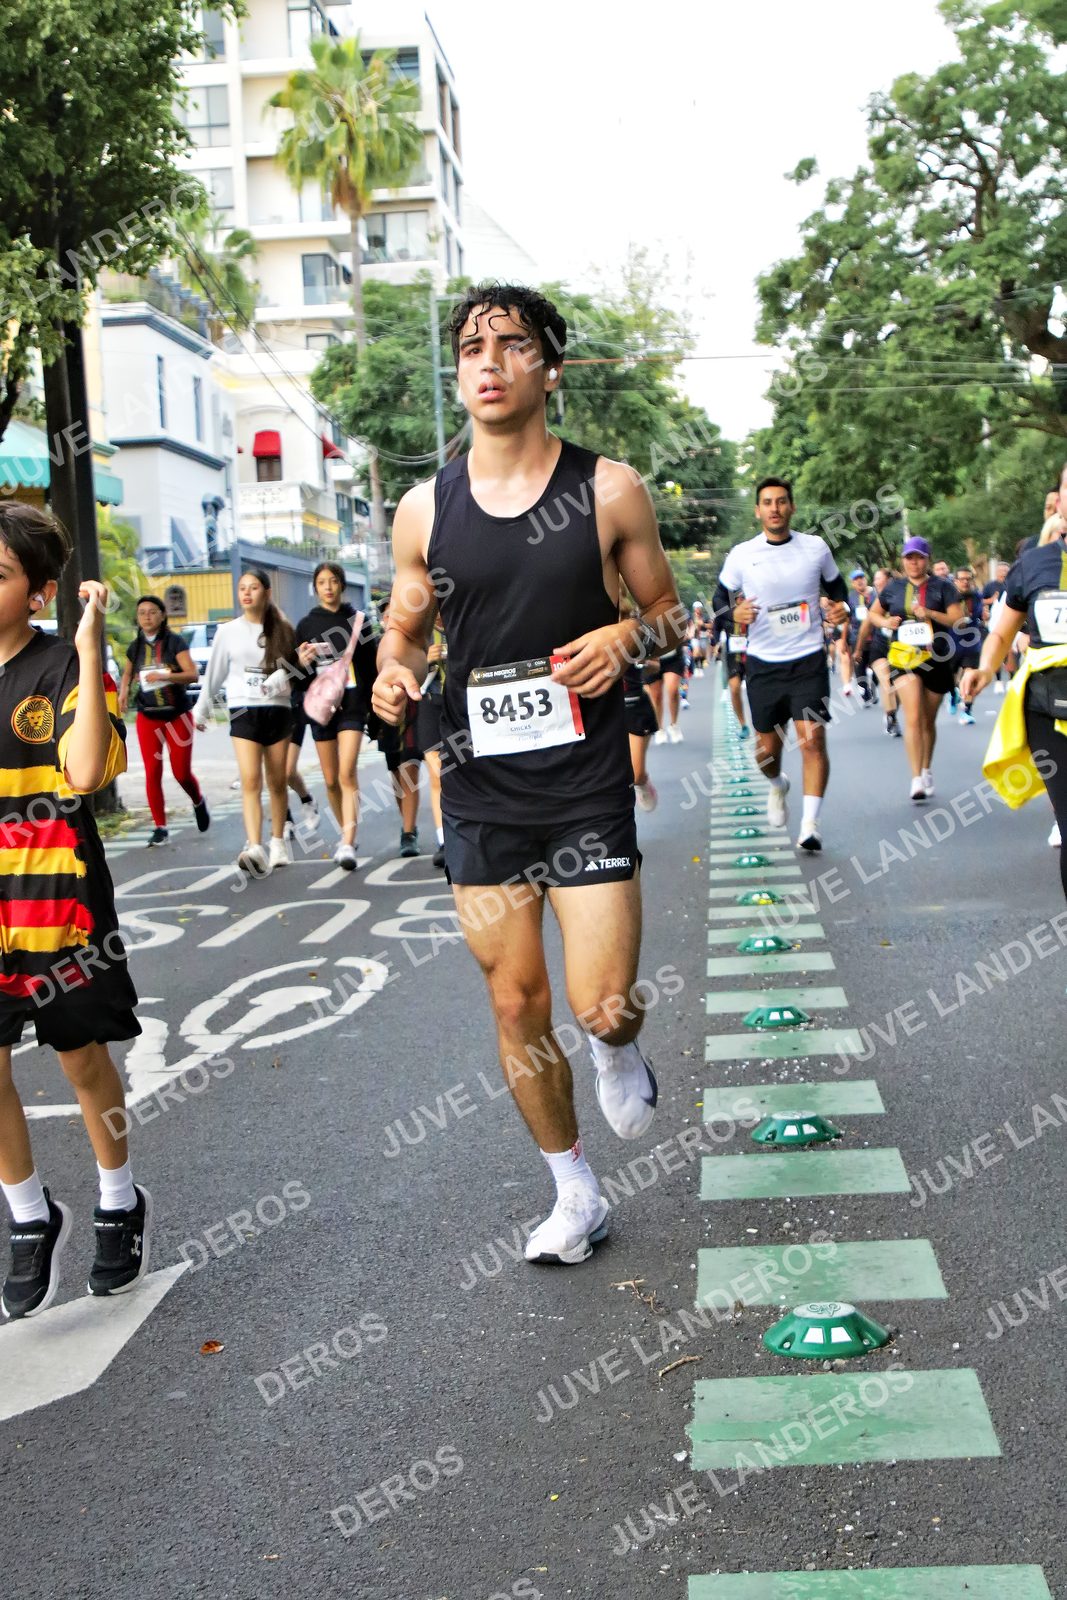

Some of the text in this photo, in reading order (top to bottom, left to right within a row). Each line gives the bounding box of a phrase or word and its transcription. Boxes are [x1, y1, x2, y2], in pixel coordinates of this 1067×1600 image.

[780, 611, 800, 625] 806
[1054, 607, 1067, 624] 7
[480, 688, 553, 725] 8453
[598, 856, 631, 870] TERREX
